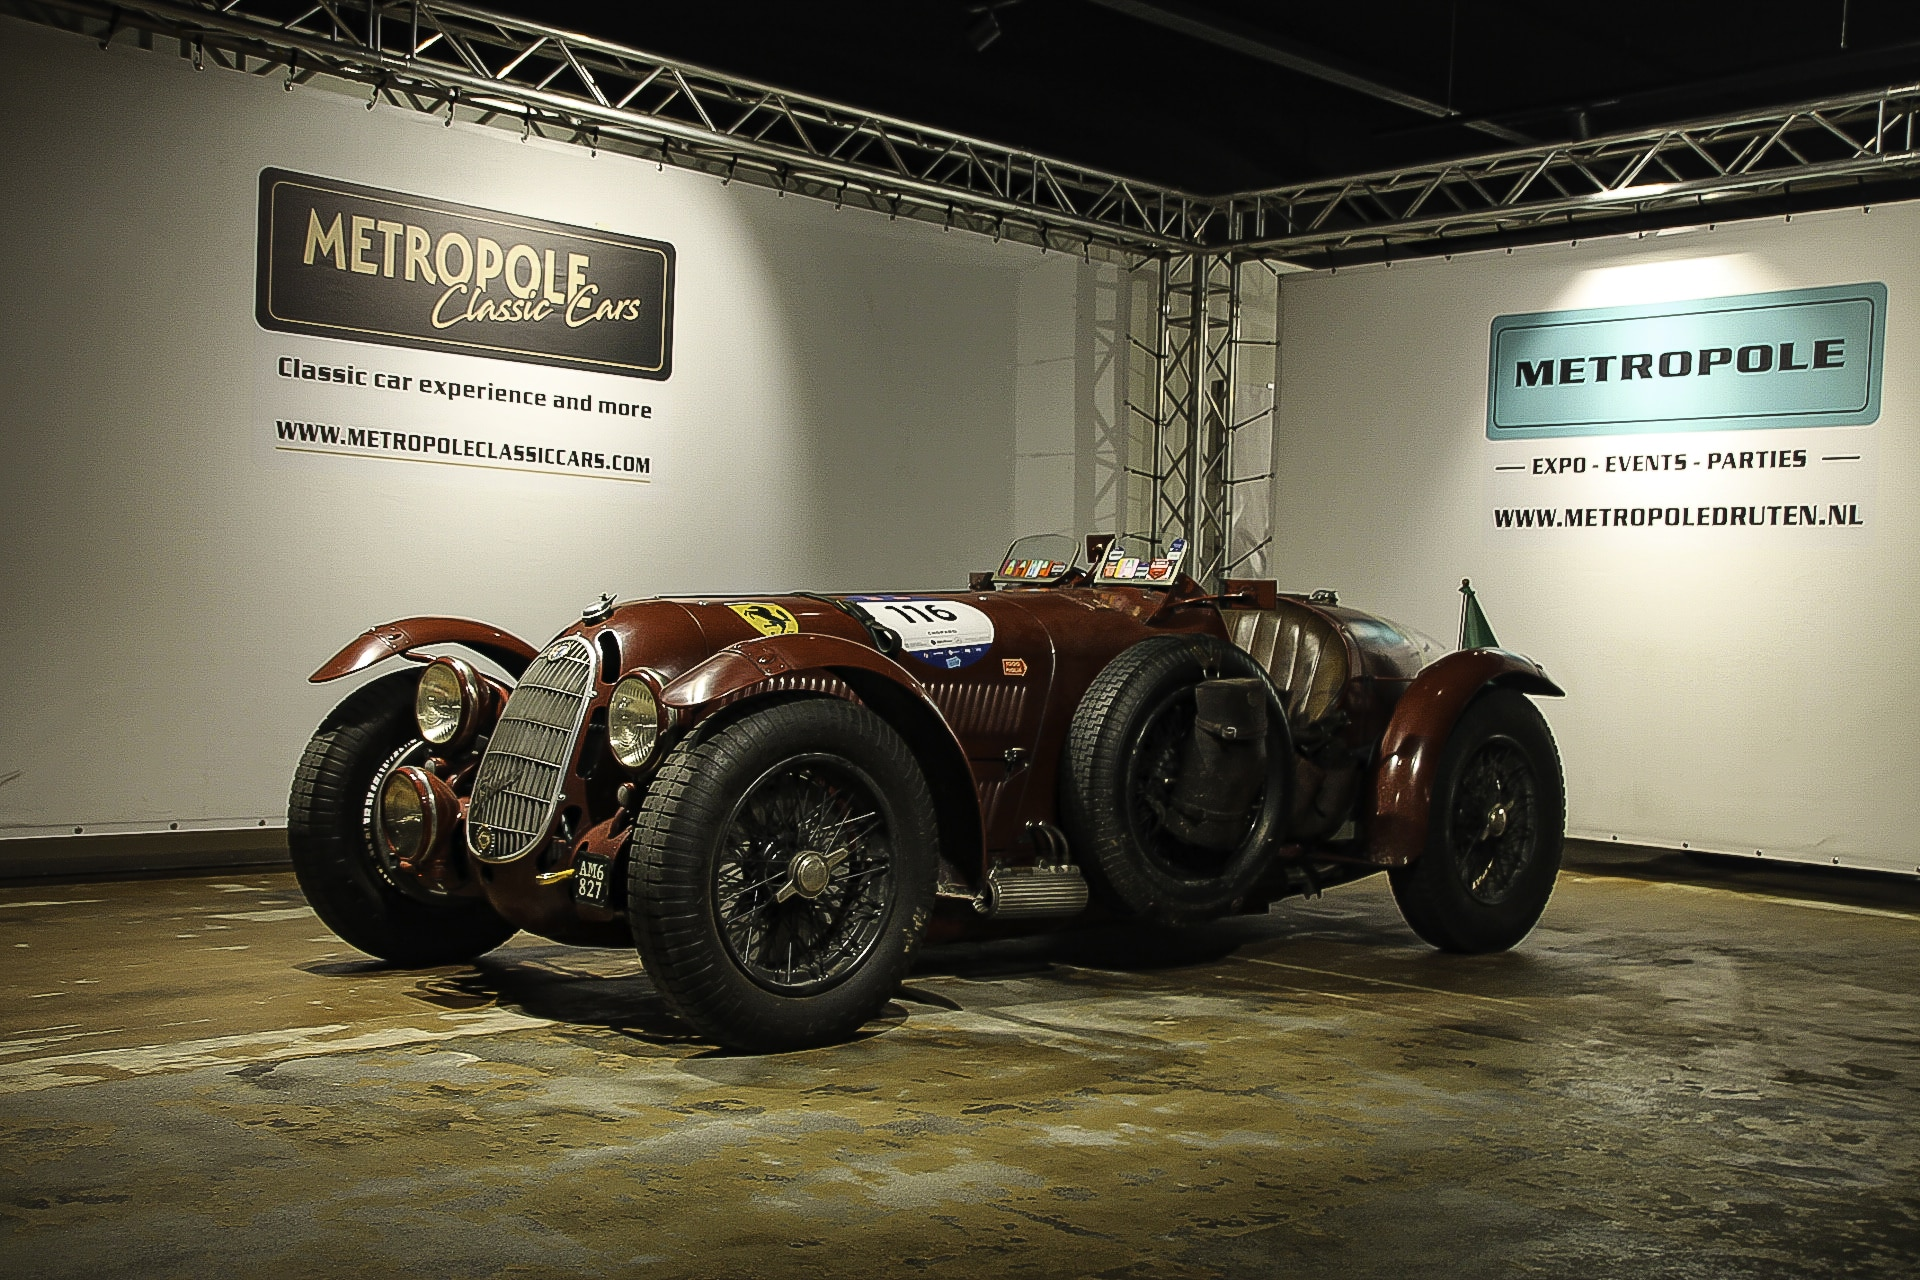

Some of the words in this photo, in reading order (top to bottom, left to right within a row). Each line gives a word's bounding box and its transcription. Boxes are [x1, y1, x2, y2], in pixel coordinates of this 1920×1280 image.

[303, 207, 592, 309] METROPOLE
[431, 283, 553, 329] Classic
[565, 284, 641, 328] Cars
[1515, 338, 1845, 388] METROPOLE
[277, 356, 367, 386] Classic
[374, 370, 412, 391] car
[419, 379, 547, 407] experience
[553, 394, 591, 413] and
[599, 400, 652, 419] more
[276, 420, 650, 474] WWW.METROPOLECLASSICCARS.COM
[1532, 456, 1587, 475] EXPO
[1605, 453, 1687, 473] EVENTS
[1708, 449, 1807, 470] PARTIES
[1494, 504, 1864, 528] WWW.METROPOLEDRUTEN.NL
[885, 604, 957, 623] 116
[579, 860, 604, 880] AM6
[579, 877, 602, 899] 827
